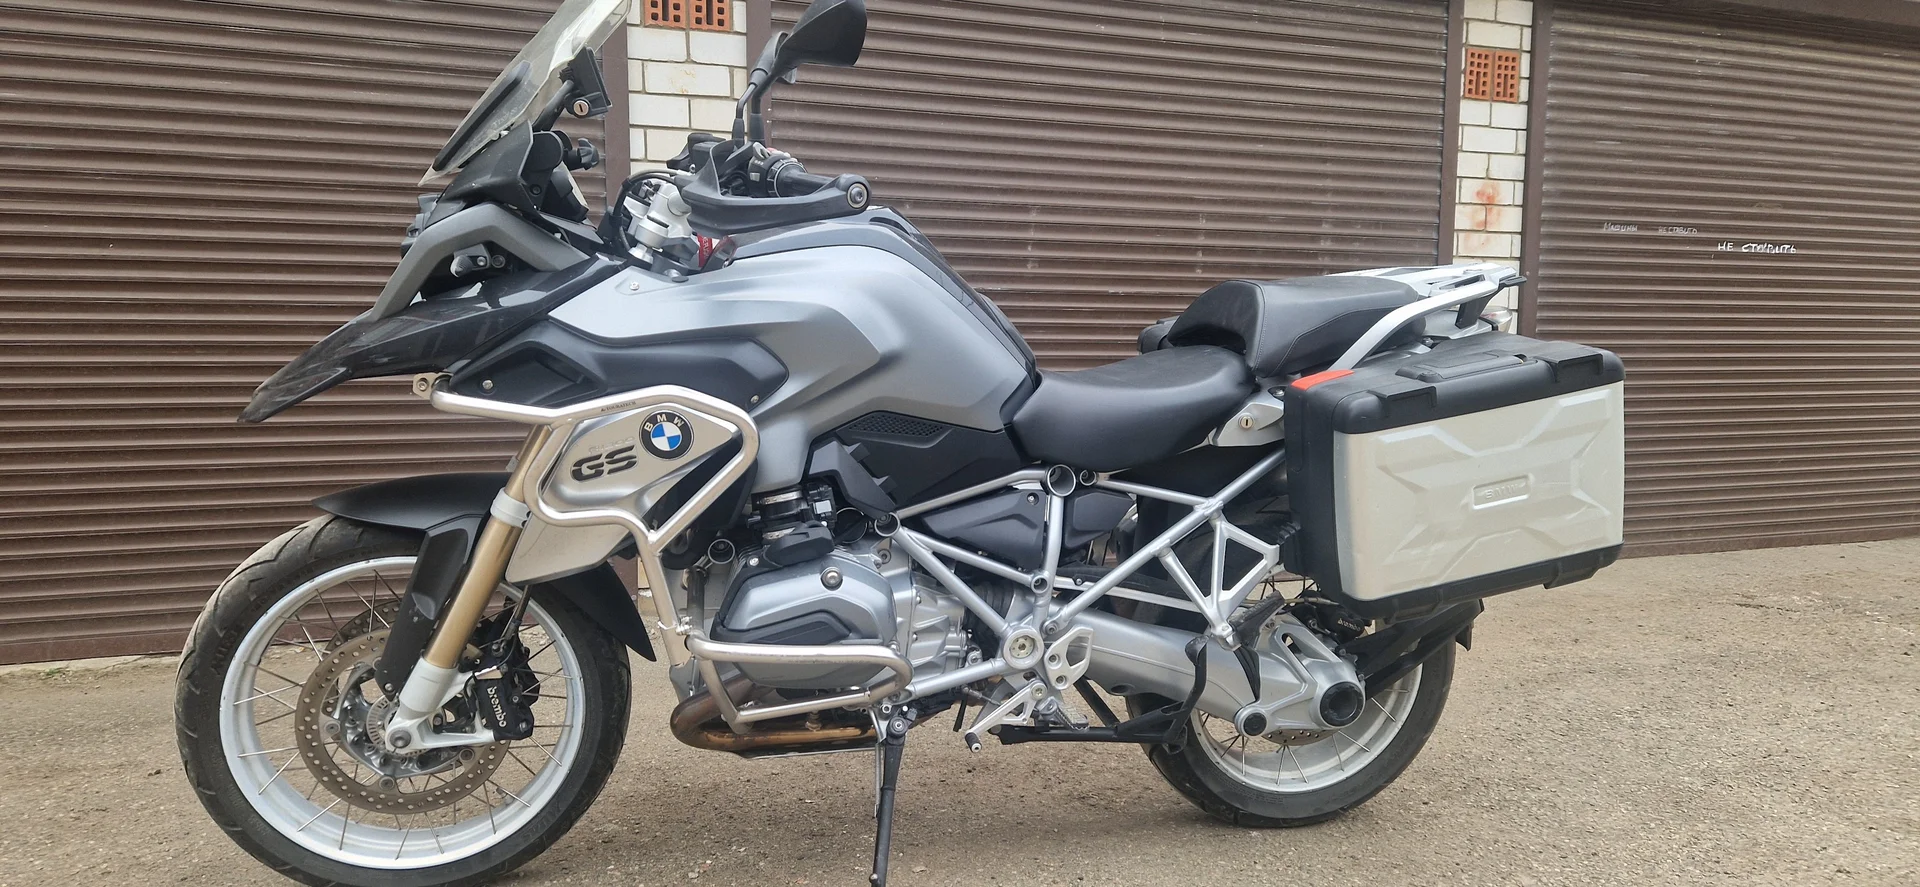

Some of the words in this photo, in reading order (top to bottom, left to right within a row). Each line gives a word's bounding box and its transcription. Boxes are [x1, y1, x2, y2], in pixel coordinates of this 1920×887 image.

[1718, 241, 1734, 251] НЕ
[644, 413, 685, 432] BMW
[571, 445, 638, 482] GS
[1337, 617, 1361, 632] brembo
[486, 686, 507, 728] brembo
